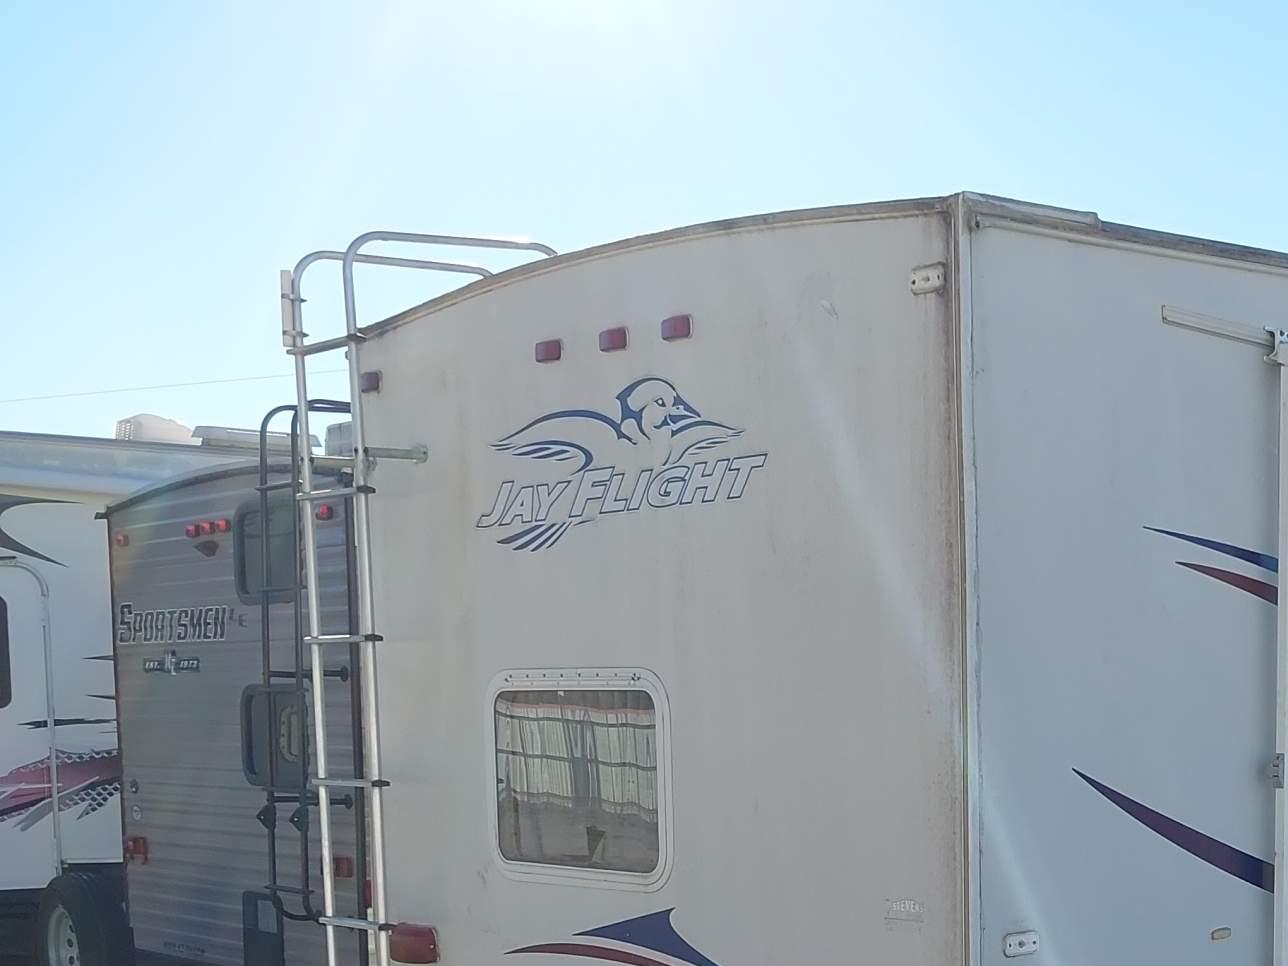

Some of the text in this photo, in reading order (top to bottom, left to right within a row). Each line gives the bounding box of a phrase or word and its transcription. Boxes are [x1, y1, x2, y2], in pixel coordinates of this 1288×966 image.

[475, 453, 768, 528] JAY FLIGHT
[119, 602, 227, 644] SPORTSMEN
